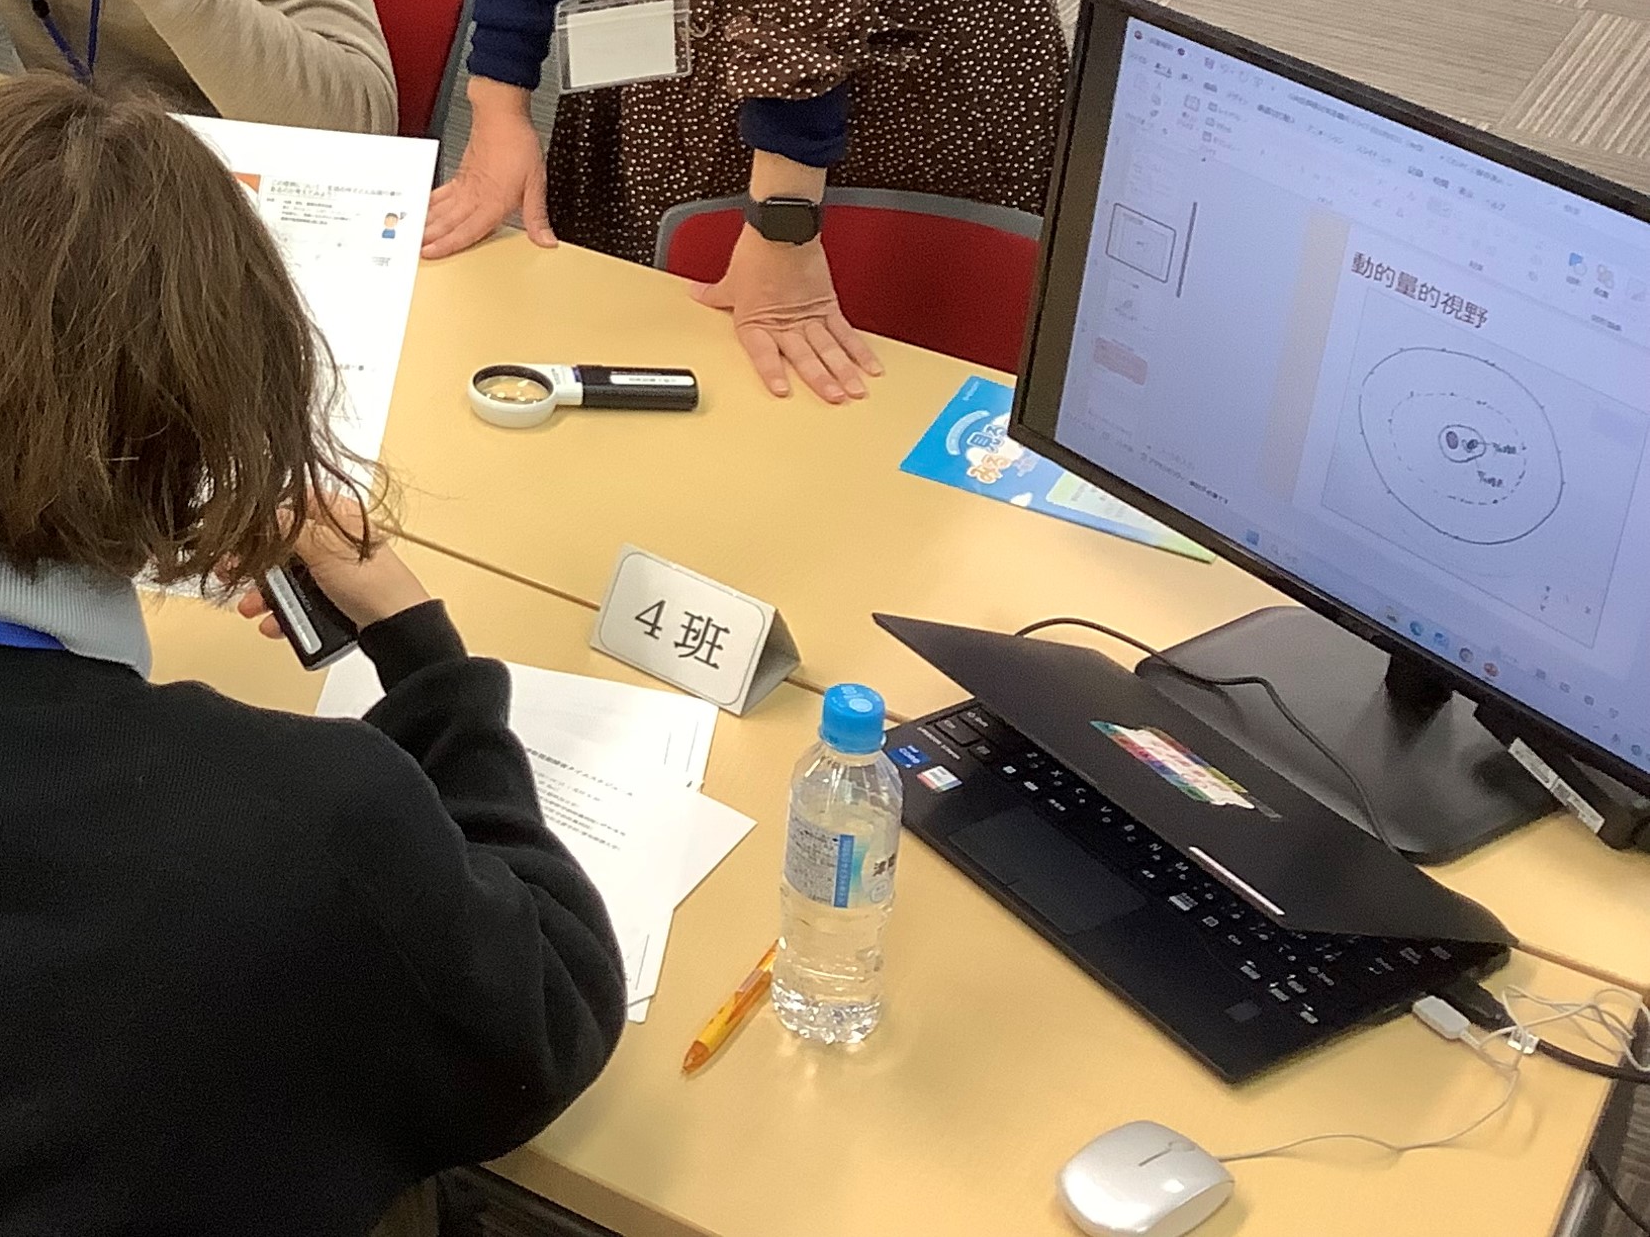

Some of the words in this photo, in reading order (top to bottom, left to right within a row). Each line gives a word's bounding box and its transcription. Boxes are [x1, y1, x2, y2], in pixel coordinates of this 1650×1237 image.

[1351, 251, 1489, 329] 動的量的視野
[634, 599, 731, 670] 4班
